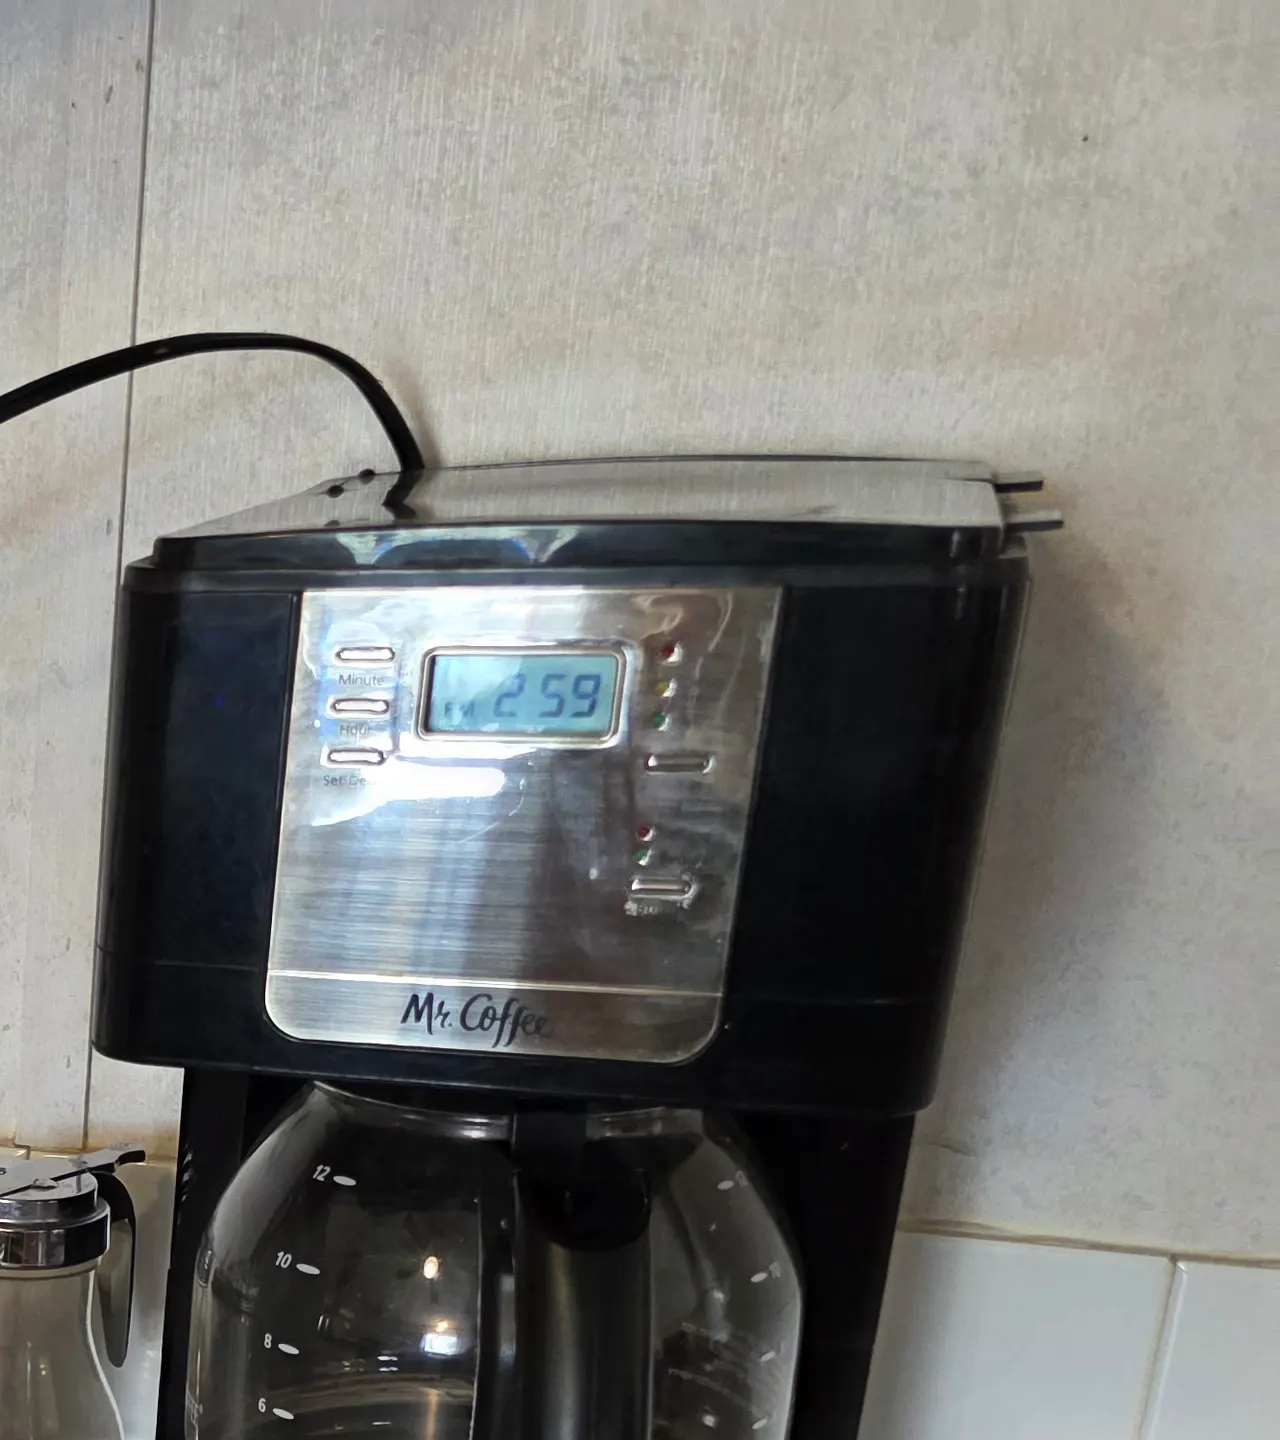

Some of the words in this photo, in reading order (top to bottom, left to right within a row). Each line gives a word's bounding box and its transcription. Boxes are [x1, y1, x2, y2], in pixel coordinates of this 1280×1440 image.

[338, 673, 385, 687] Minute
[339, 723, 372, 736] Hour
[400, 991, 453, 1036] Mr.
[459, 992, 553, 1049] Coffee
[312, 1164, 331, 1182] 12
[275, 1251, 292, 1269] 10
[263, 1332, 272, 1349] 8
[258, 1397, 267, 1413] 6
